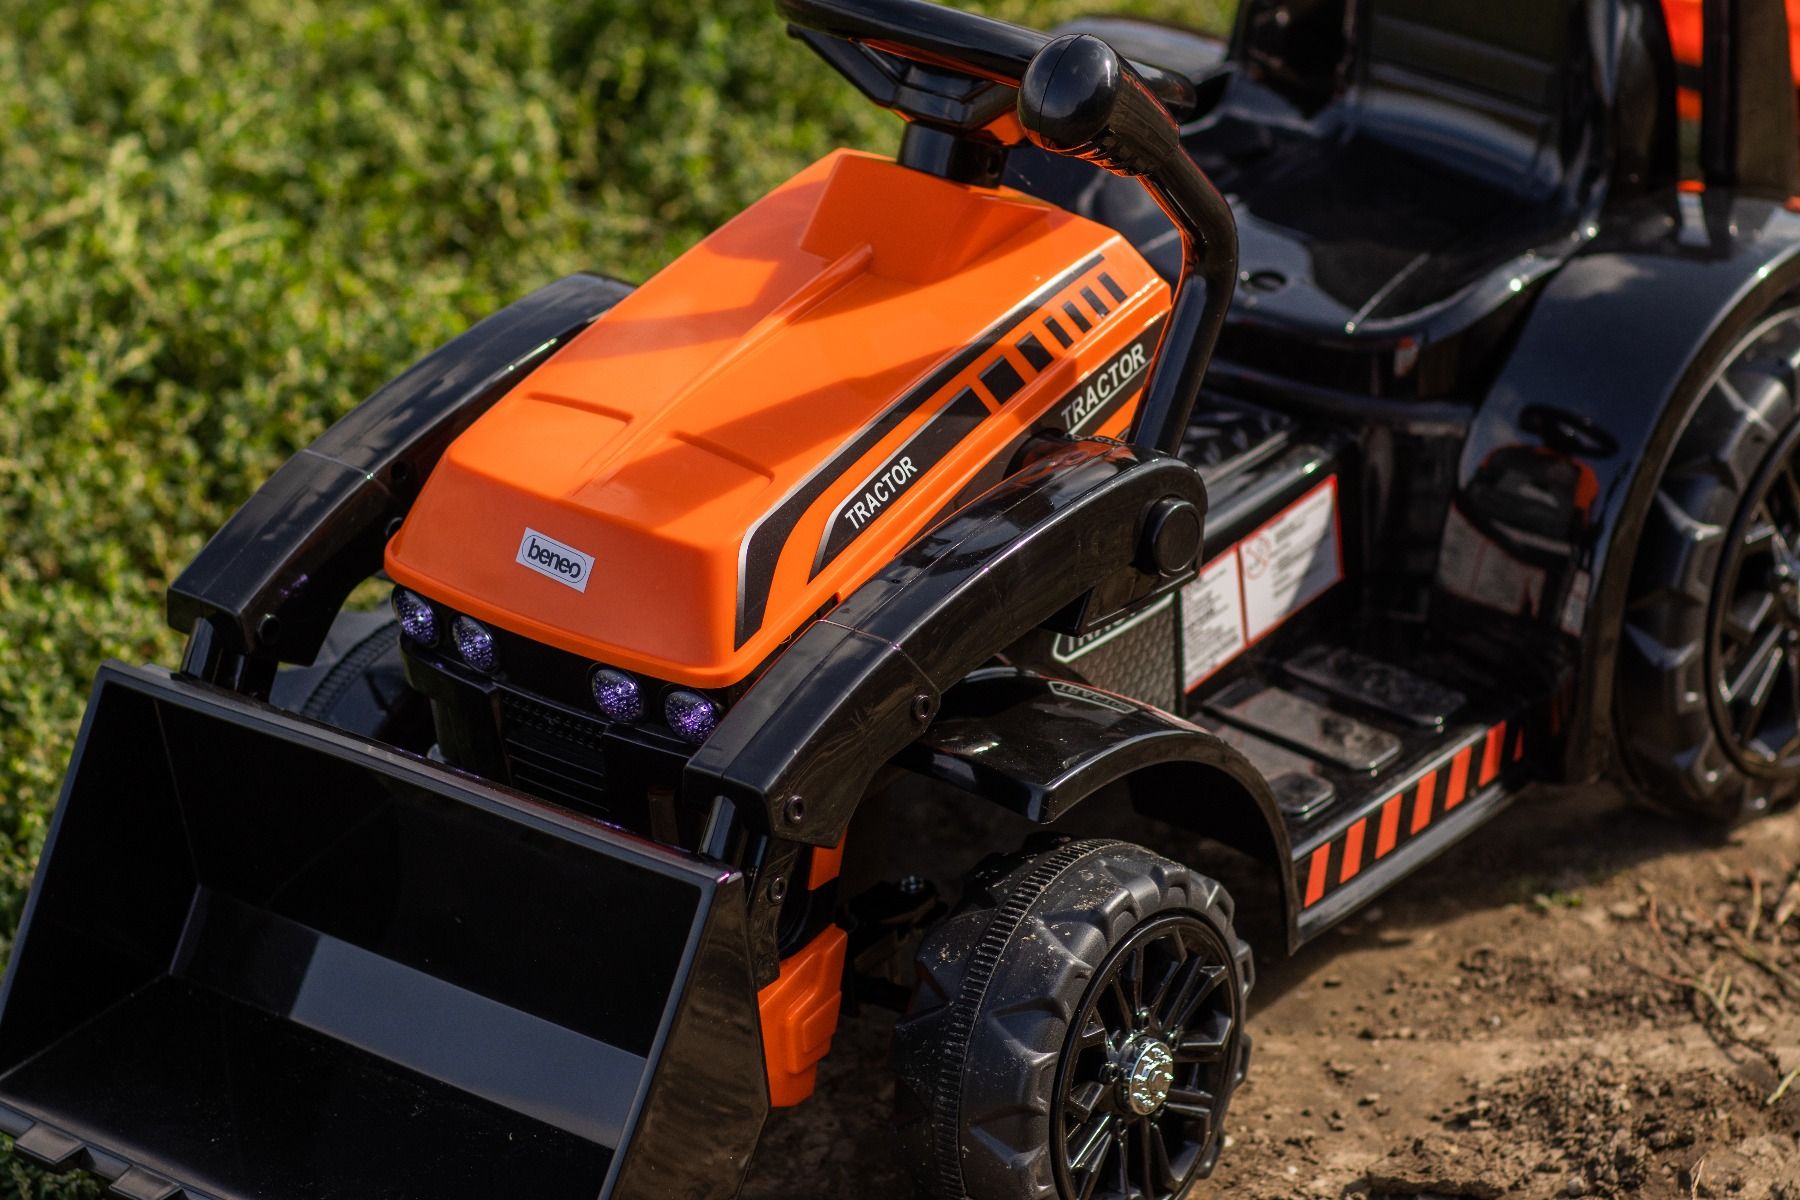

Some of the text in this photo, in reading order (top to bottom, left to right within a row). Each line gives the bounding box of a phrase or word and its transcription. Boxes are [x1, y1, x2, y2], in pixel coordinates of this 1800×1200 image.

[1061, 343, 1146, 430] TRACTOR
[844, 456, 918, 529] TRACTOR
[527, 538, 581, 578] beneo
